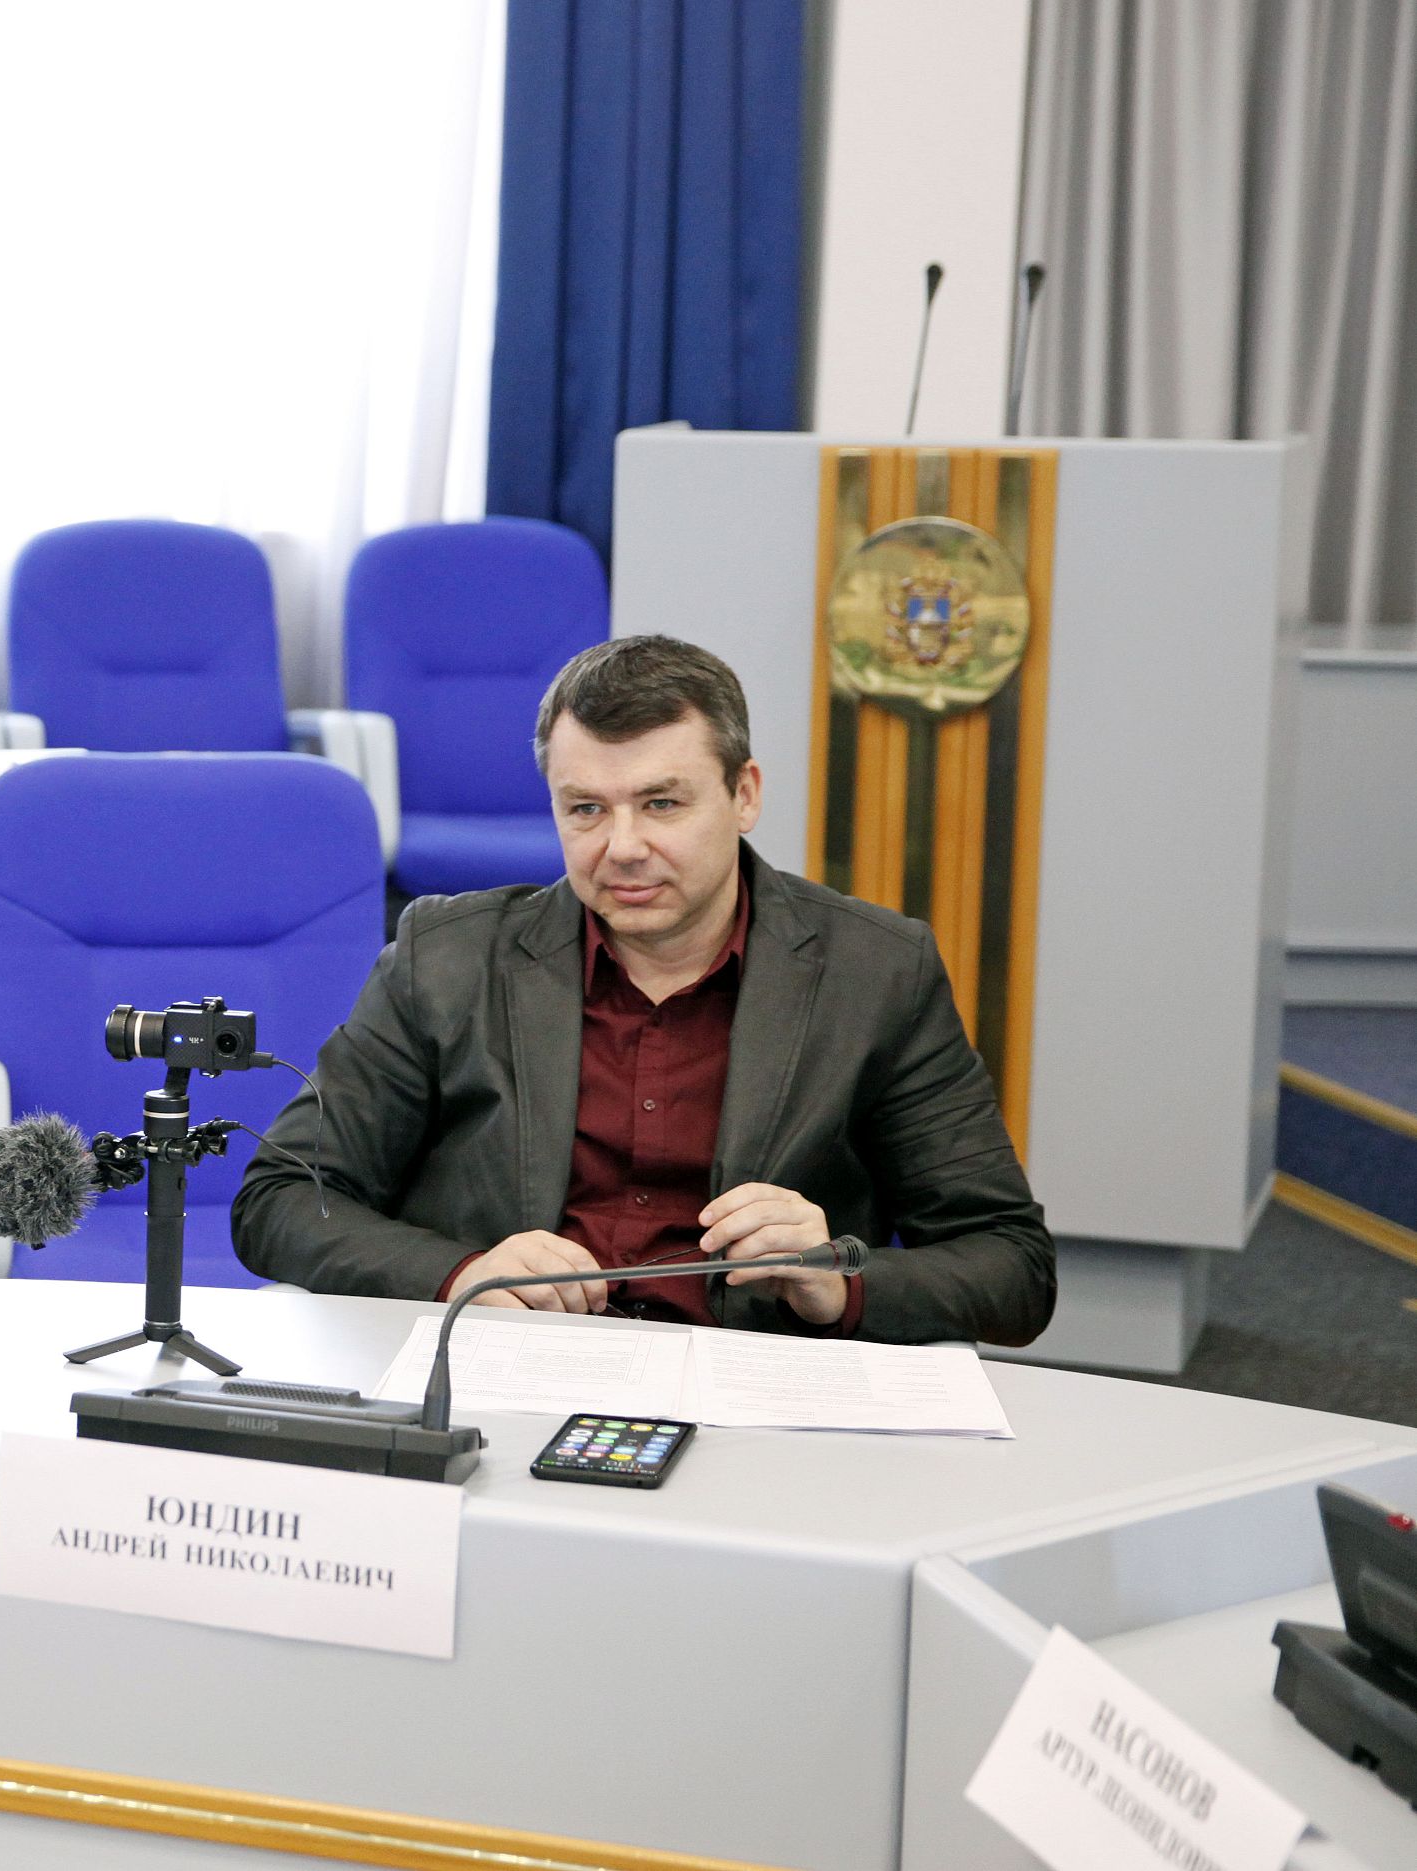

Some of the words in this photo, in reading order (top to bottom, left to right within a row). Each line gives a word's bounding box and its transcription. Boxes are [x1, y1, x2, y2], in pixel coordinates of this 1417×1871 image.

[226, 1415, 279, 1432] PHILIPS
[146, 1495, 301, 1540] ЮНДИН
[51, 1527, 168, 1560] АНДРЕЙ
[185, 1544, 395, 1591] НИКОЛАЕВИЧ
[1089, 1698, 1218, 1822] НАСОНОВ
